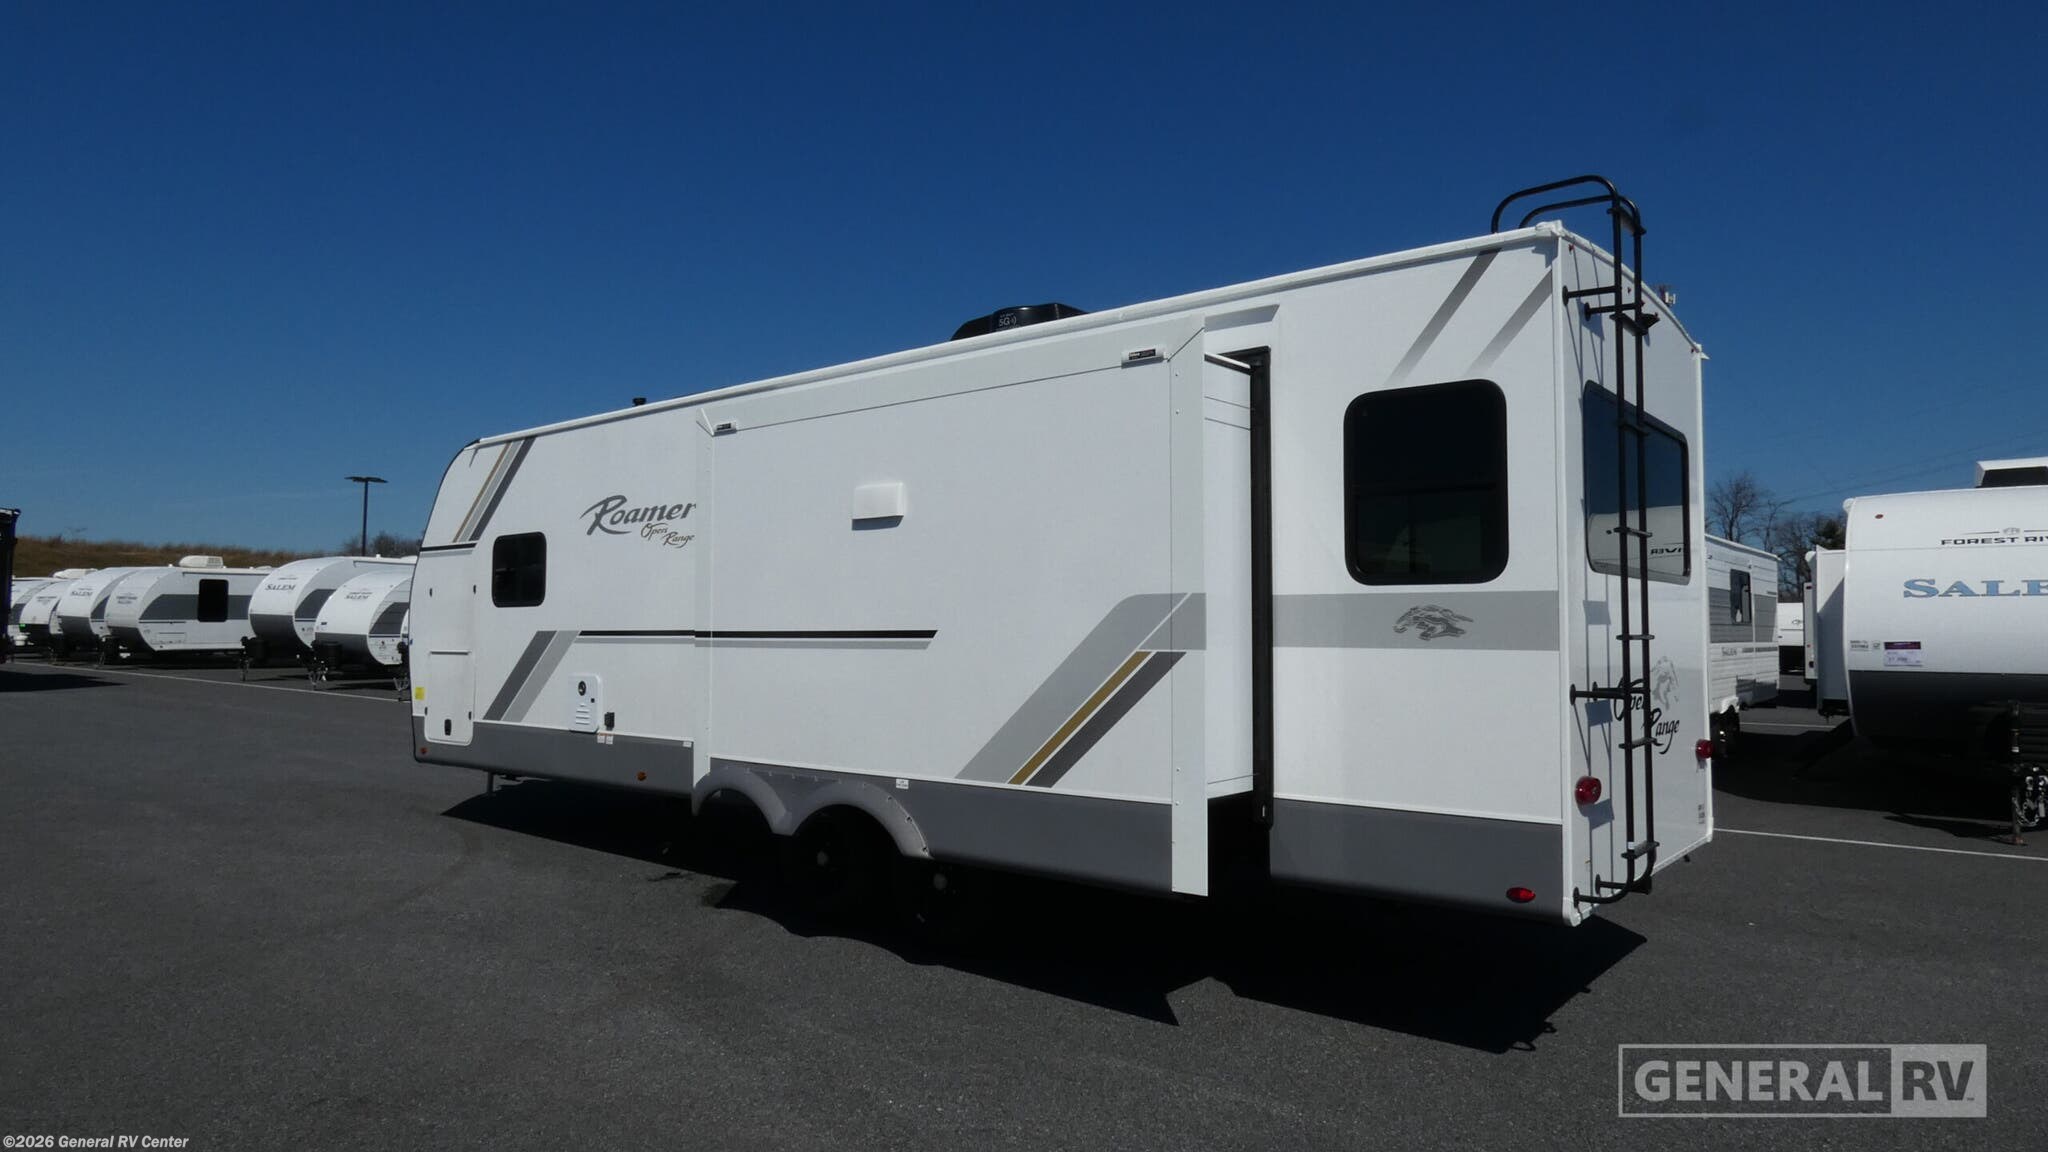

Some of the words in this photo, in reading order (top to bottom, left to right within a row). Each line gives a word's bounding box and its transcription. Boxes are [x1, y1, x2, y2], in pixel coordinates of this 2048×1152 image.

[580, 495, 697, 535] Roamer
[640, 522, 669, 541] Open
[662, 531, 695, 549] Range
[1941, 536, 2019, 546] FOREST
[264, 583, 297, 592] SALEM
